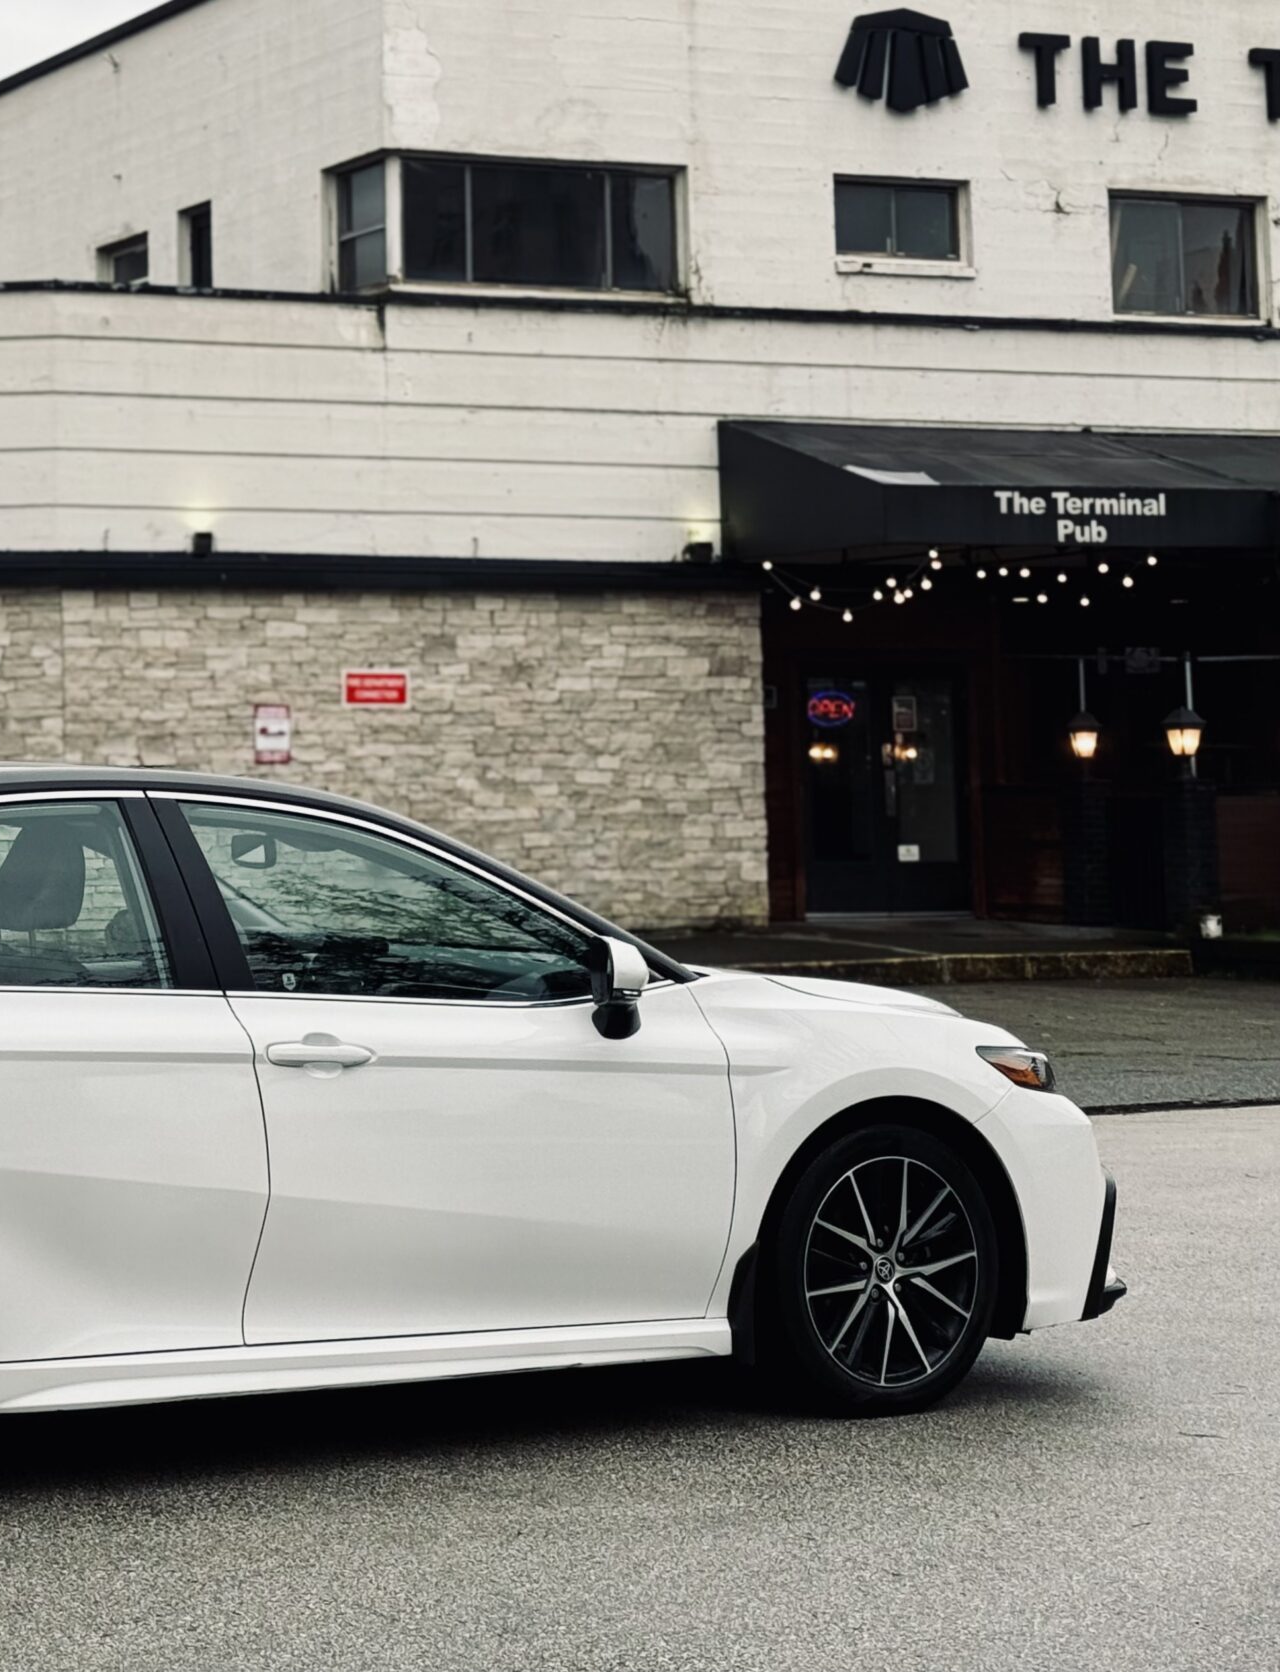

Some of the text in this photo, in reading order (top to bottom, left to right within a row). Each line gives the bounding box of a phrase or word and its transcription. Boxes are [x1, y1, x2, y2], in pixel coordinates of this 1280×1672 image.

[1018, 32, 1197, 117] THE
[994, 490, 1166, 516] The Terminal
[1057, 519, 1108, 543] Pub
[808, 698, 855, 718] OPEN
